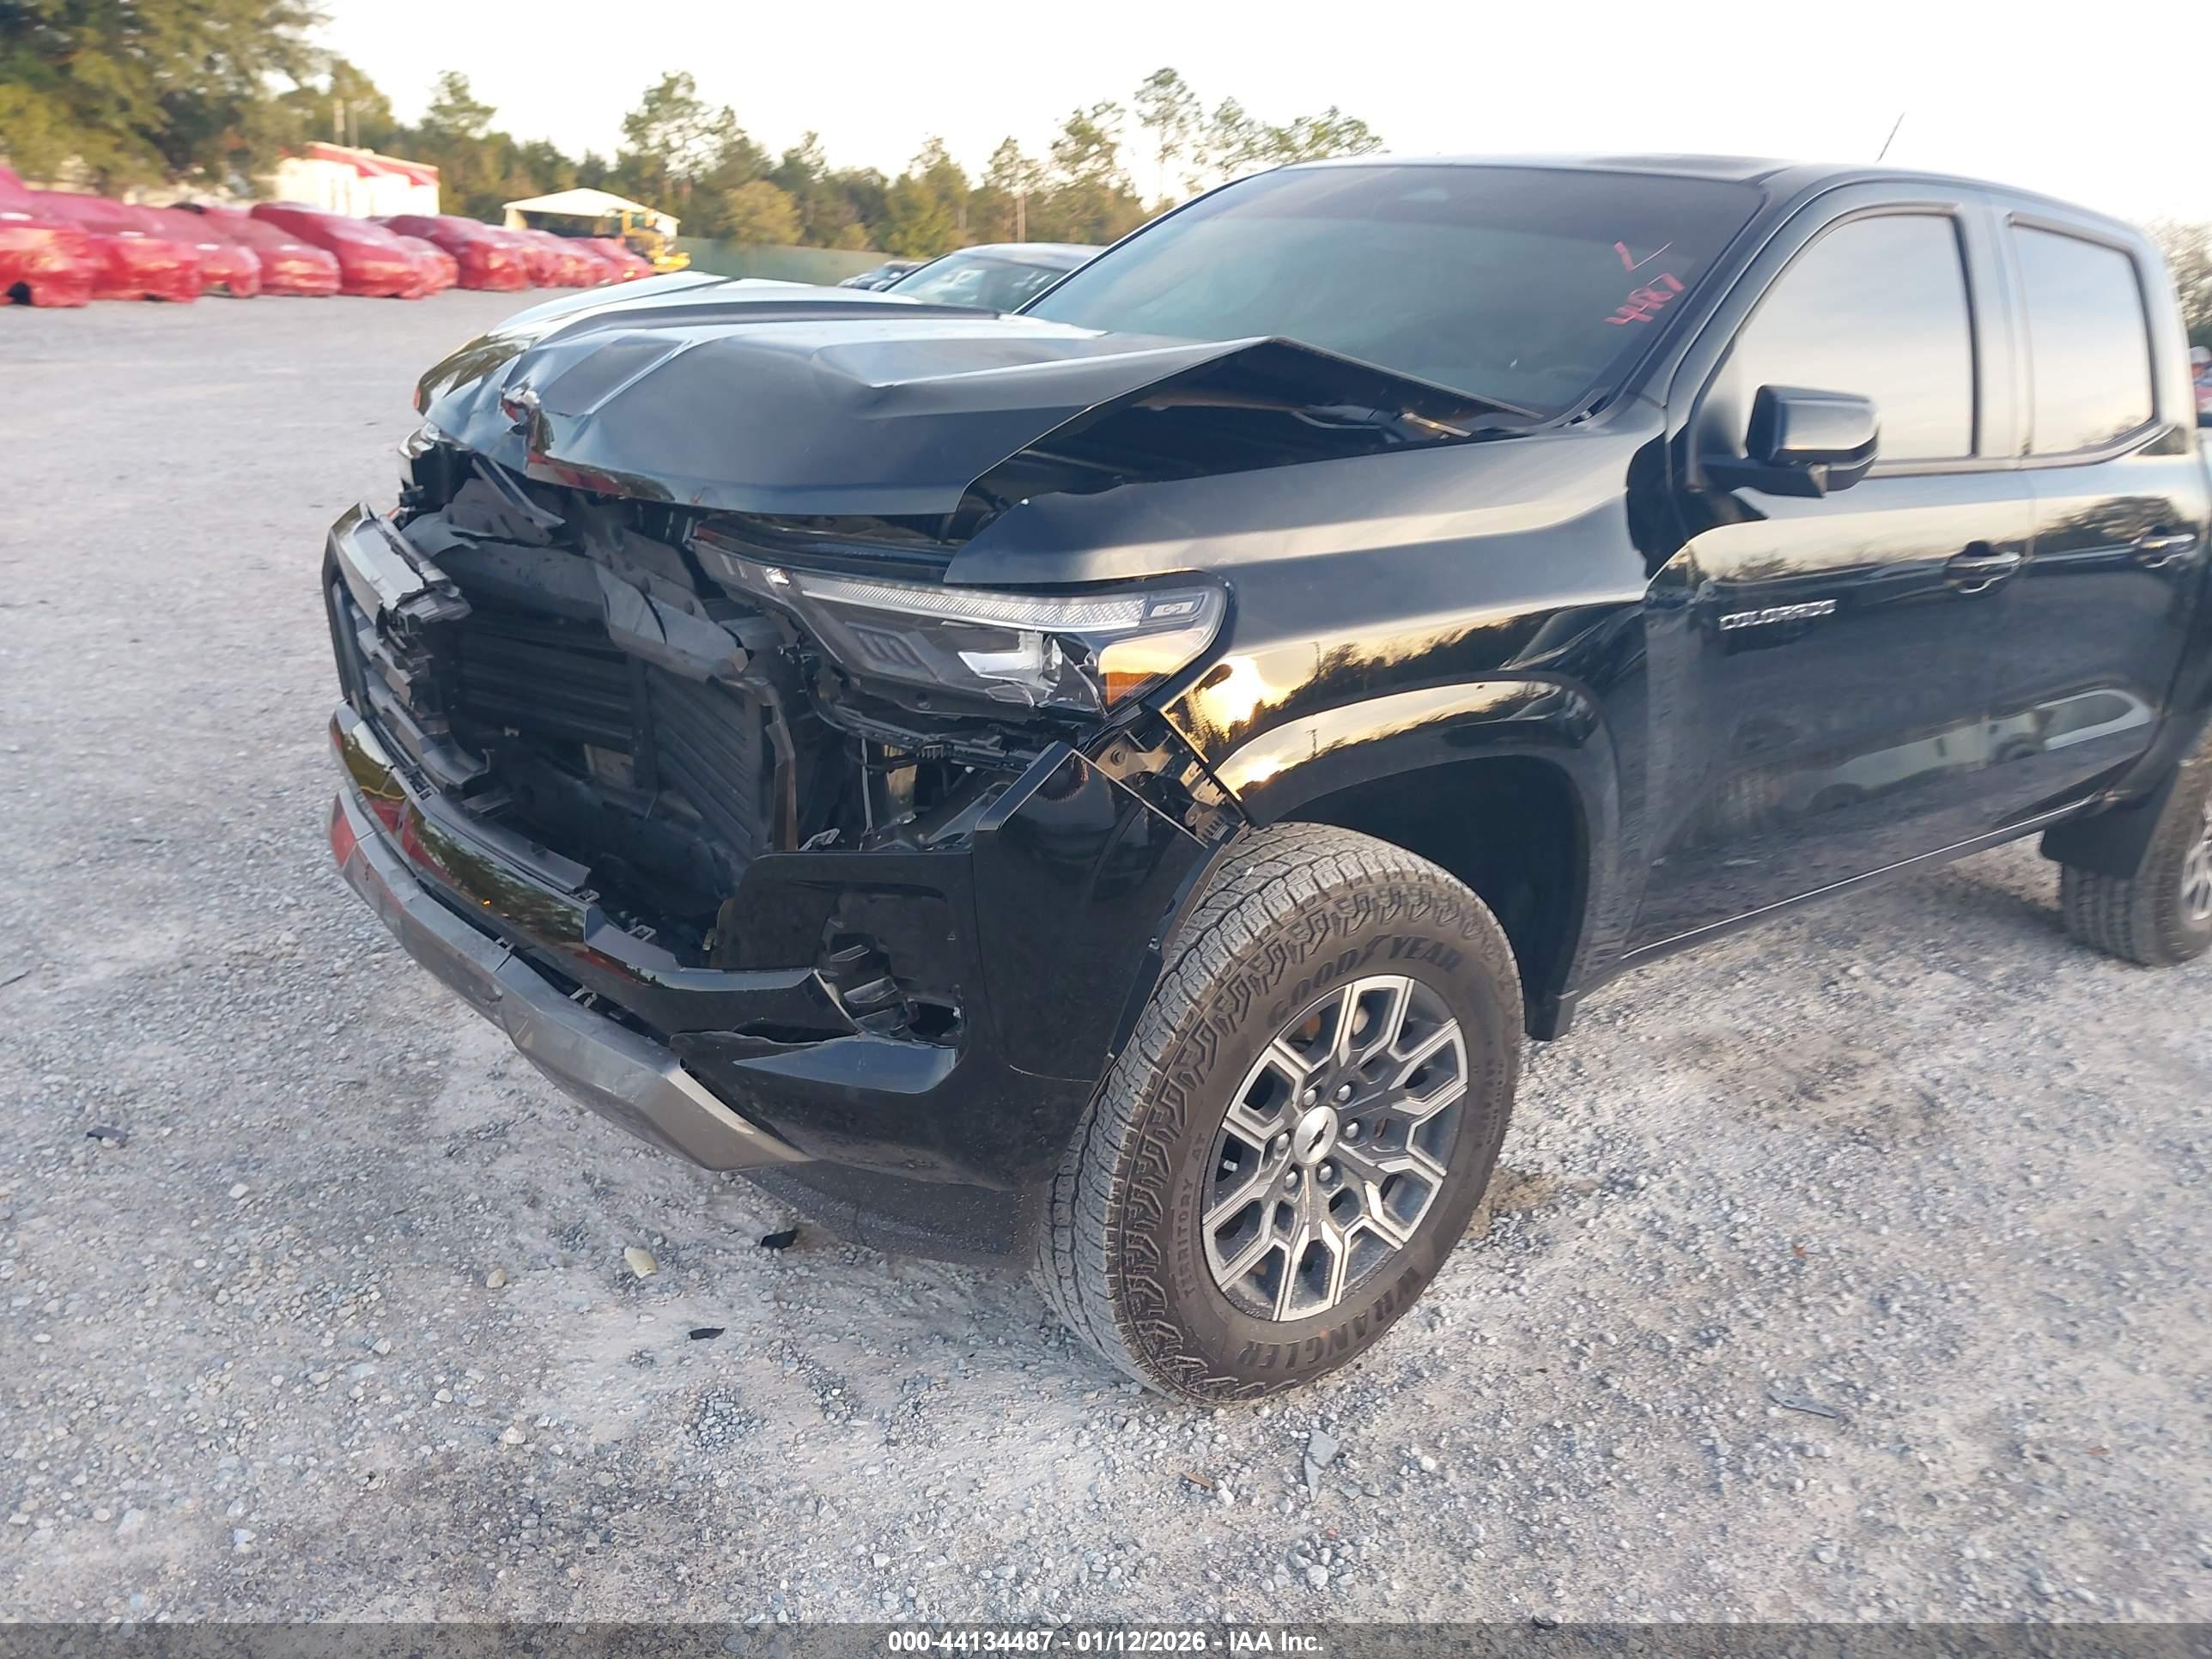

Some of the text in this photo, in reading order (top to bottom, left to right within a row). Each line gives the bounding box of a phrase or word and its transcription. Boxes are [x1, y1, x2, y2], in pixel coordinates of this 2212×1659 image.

[1718, 599, 1838, 630] COLORADO
[1177, 1178, 1197, 1298] TERRITORY
[1235, 1267, 1422, 1371] WRANGLER
